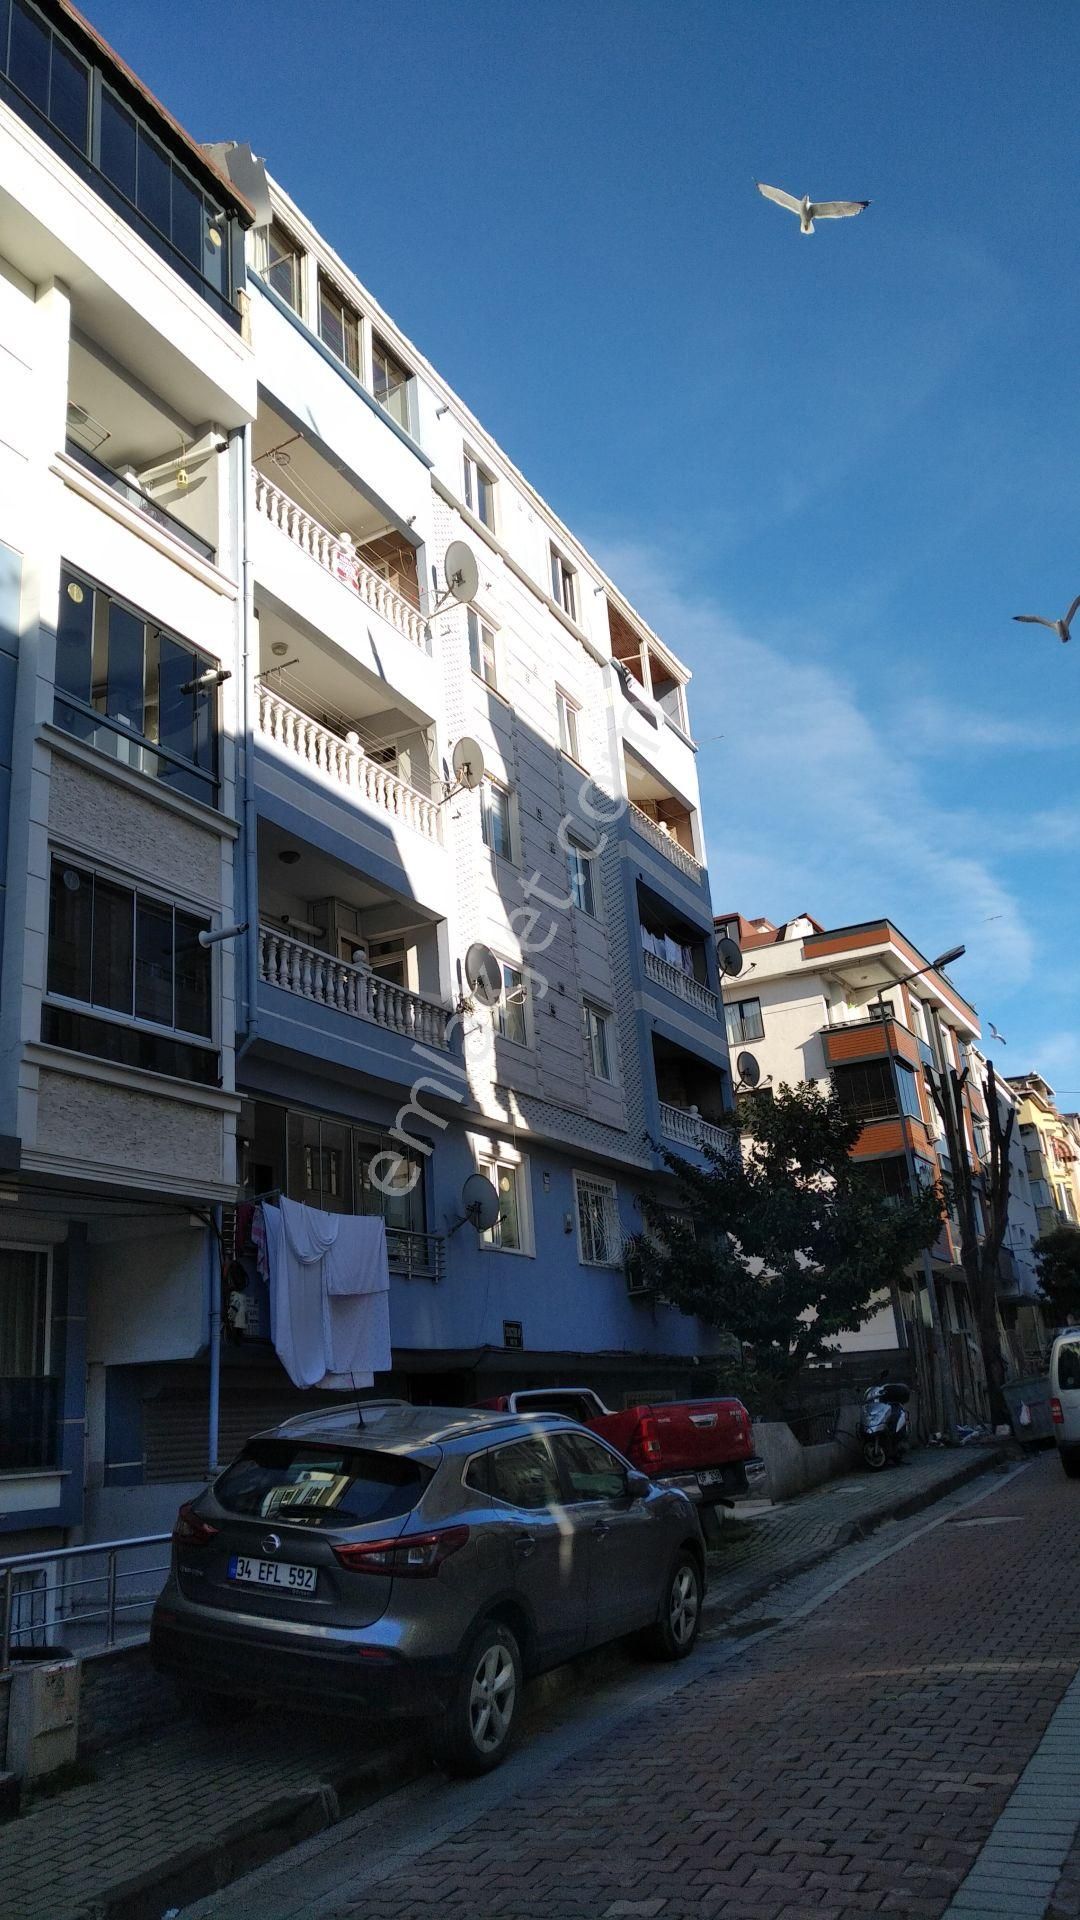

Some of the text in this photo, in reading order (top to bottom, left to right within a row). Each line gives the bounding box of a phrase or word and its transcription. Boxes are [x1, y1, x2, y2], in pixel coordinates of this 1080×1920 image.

[237, 1559, 313, 1588] 34 EFL 592
